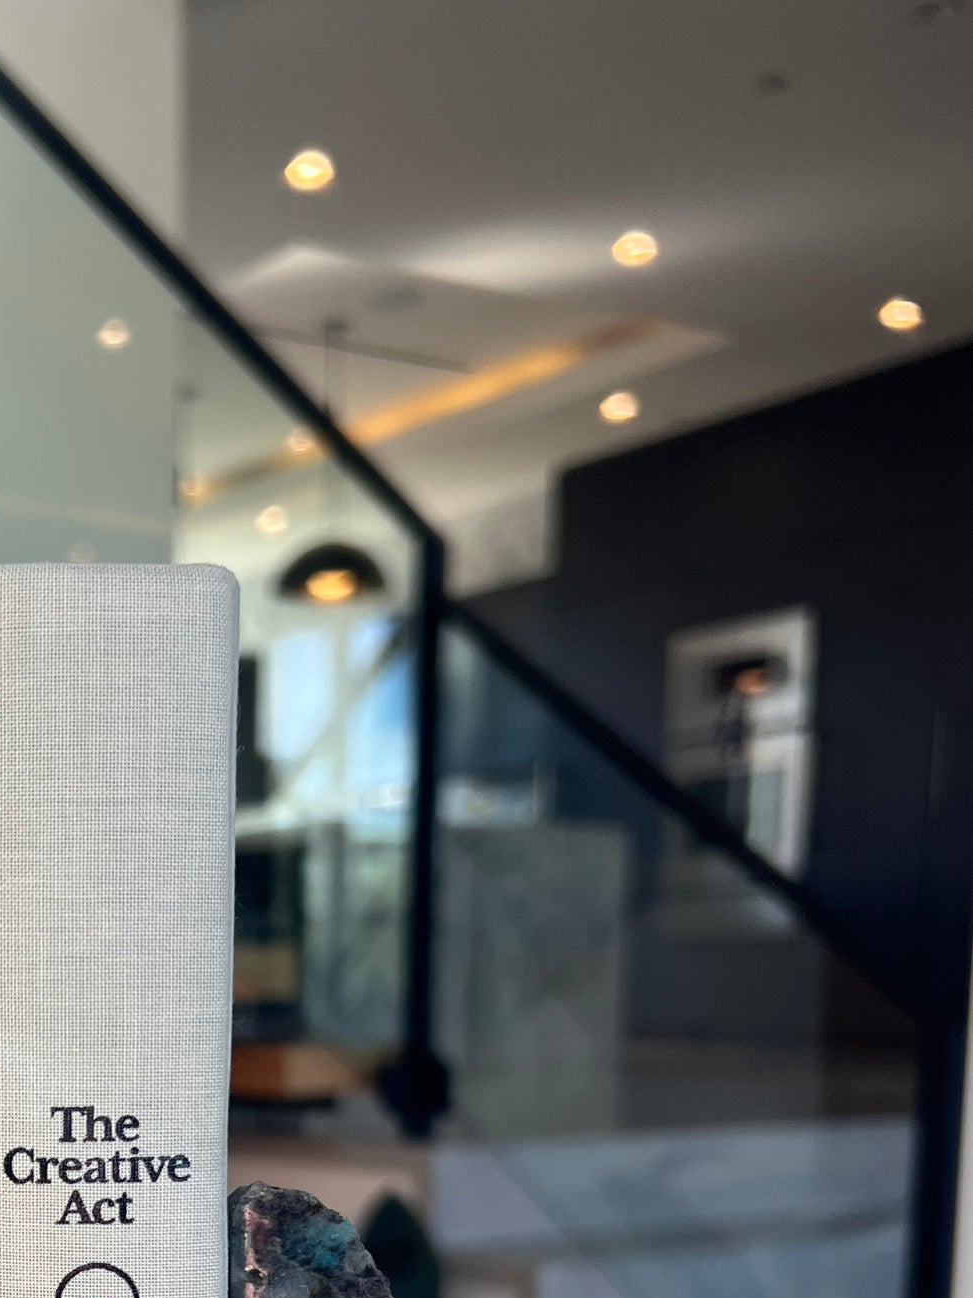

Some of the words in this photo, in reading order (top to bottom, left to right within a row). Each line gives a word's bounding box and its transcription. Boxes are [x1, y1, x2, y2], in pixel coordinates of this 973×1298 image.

[51, 1105, 140, 1143] The
[3, 1146, 191, 1184] Creative
[56, 1190, 135, 1225] Act
